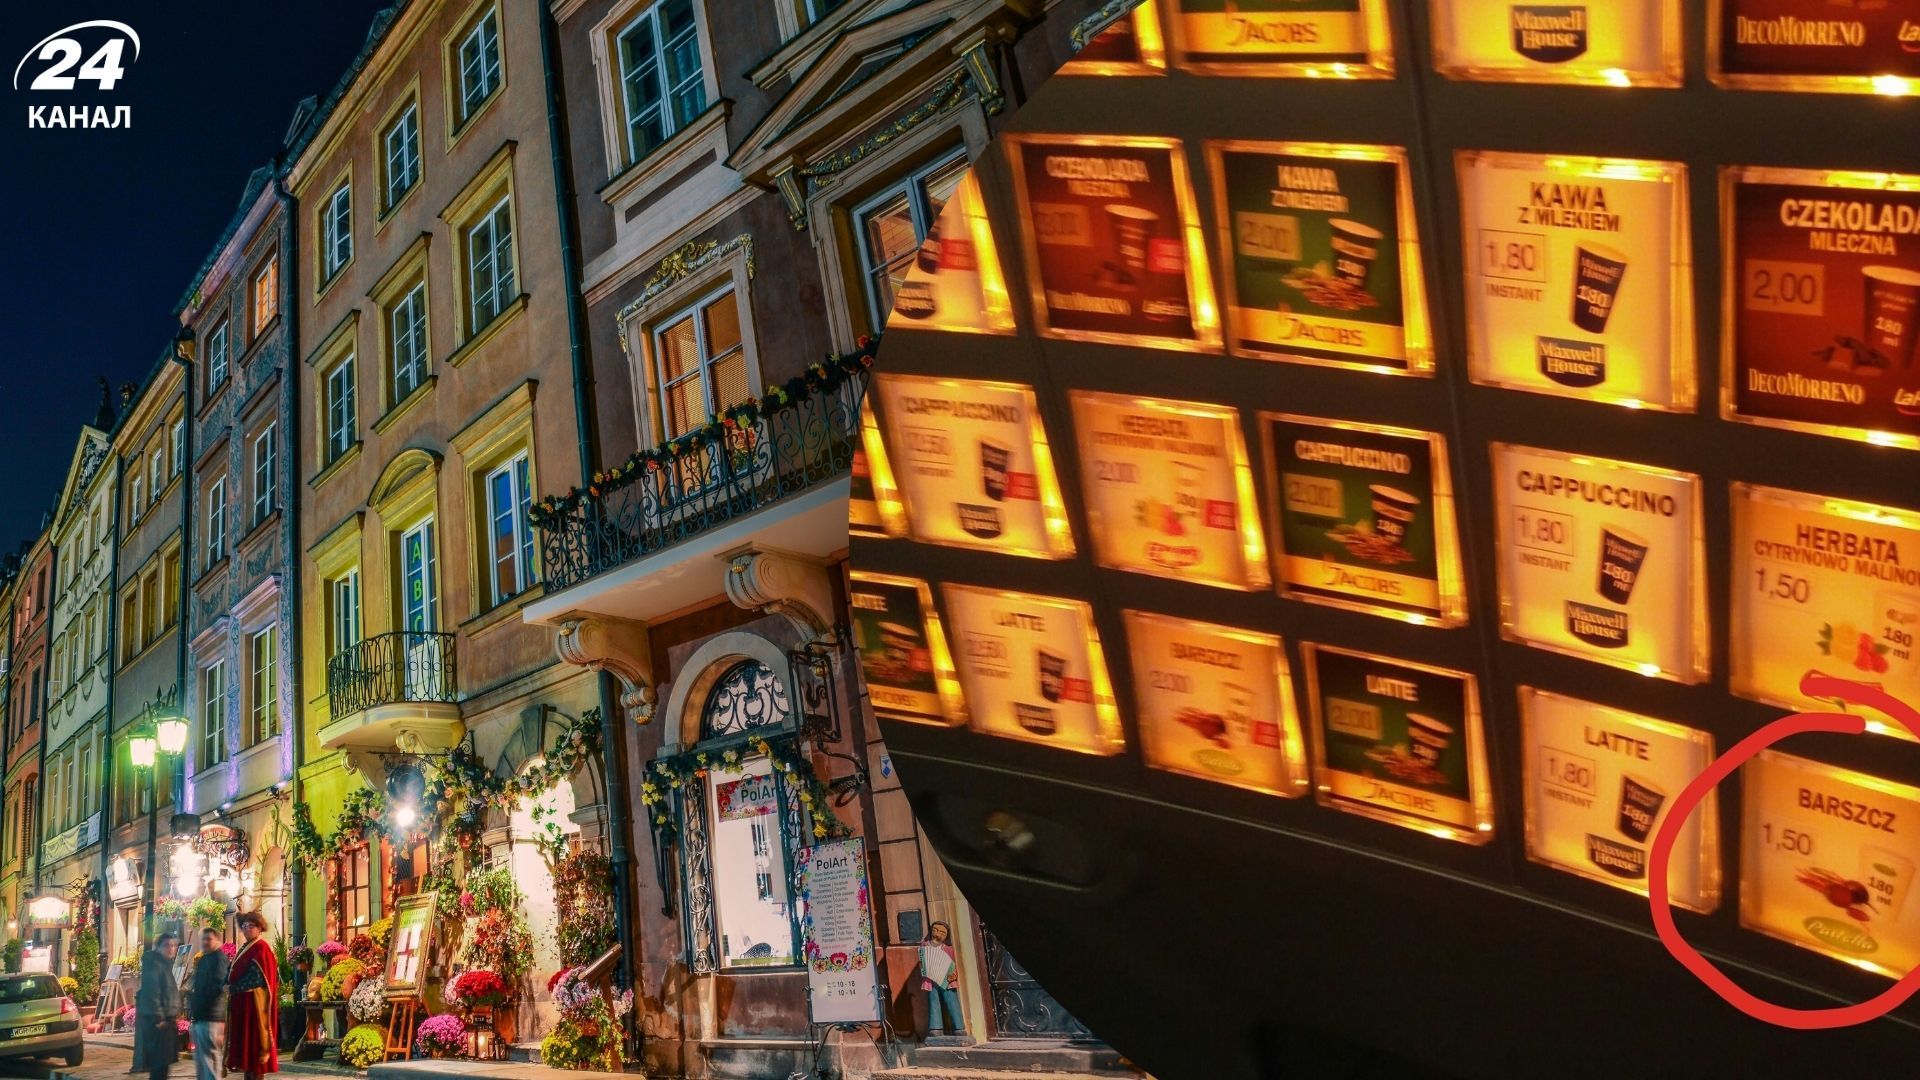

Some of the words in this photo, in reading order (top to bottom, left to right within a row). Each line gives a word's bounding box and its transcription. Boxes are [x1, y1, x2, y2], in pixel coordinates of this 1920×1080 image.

[1514, 9, 1586, 30] Maxwell
[1522, 30, 1578, 49] House
[1529, 181, 1608, 212] KAWA
[1517, 206, 1530, 225] Z
[1533, 208, 1620, 233] MLEKIEM
[1810, 231, 1897, 256] MLECZNA
[1485, 240, 1536, 272] 1,80
[1486, 283, 1543, 302] INSTANT
[1753, 269, 1817, 305] 2,00
[1874, 316, 1903, 336] 180
[1539, 341, 1601, 364] Maxwell
[1547, 357, 1598, 377] House
[1517, 470, 1676, 517] CAPPUCCINO
[1517, 514, 1564, 545] 1,80
[1796, 524, 1900, 565] HERBATA
[1519, 552, 1571, 572] INSTANT
[1601, 561, 1635, 583] 180
[1754, 539, 1849, 572] CYTRYNOWO
[1854, 558, 1920, 588] MALINO
[1754, 567, 1810, 605] 1,50
[1568, 605, 1626, 630] Maxwell
[1574, 620, 1622, 641] House
[1883, 626, 1913, 648] 180
[1892, 648, 1910, 661] ml
[1584, 725, 1649, 762] LATTE
[1547, 757, 1590, 789] 1,80
[741, 785, 776, 804] PolAr
[1797, 787, 1896, 834] BARSZCZ
[1589, 837, 1643, 865] Maxwell
[1762, 822, 1812, 856] 1,50
[816, 856, 848, 871] PolArt
[1595, 850, 1640, 873] House
[1867, 875, 1894, 896] 180
[1876, 895, 1892, 907] ml
